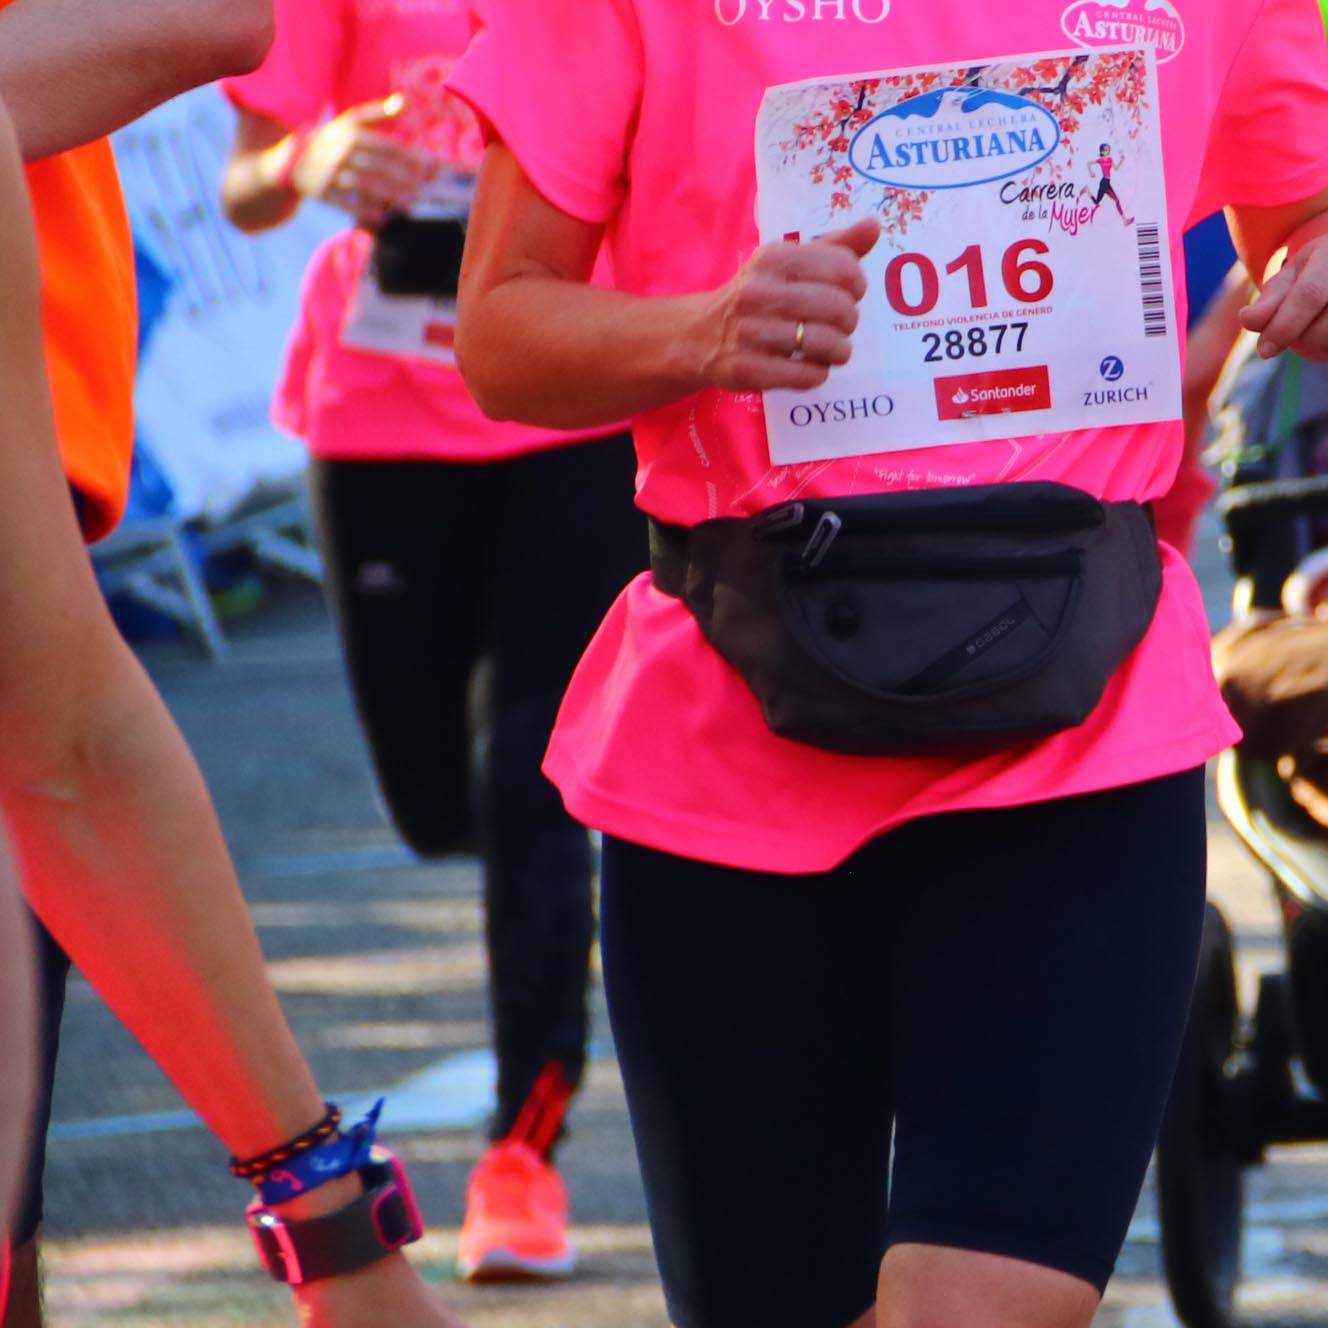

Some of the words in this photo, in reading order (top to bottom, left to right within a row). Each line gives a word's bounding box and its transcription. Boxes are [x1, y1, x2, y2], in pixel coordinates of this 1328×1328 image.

[1073, 10, 1177, 51] ASTURIANA
[866, 127, 1046, 171] ASTURIANA
[1000, 180, 1076, 205] Carrera
[1022, 205, 1036, 221] de
[1038, 204, 1048, 219] la
[1048, 197, 1100, 236] Mujer
[884, 238, 1054, 317] 016
[921, 322, 1028, 363] 28877
[790, 394, 895, 427] OYSHO
[970, 384, 1037, 403] Santander
[1083, 387, 1148, 407] ZURICH
